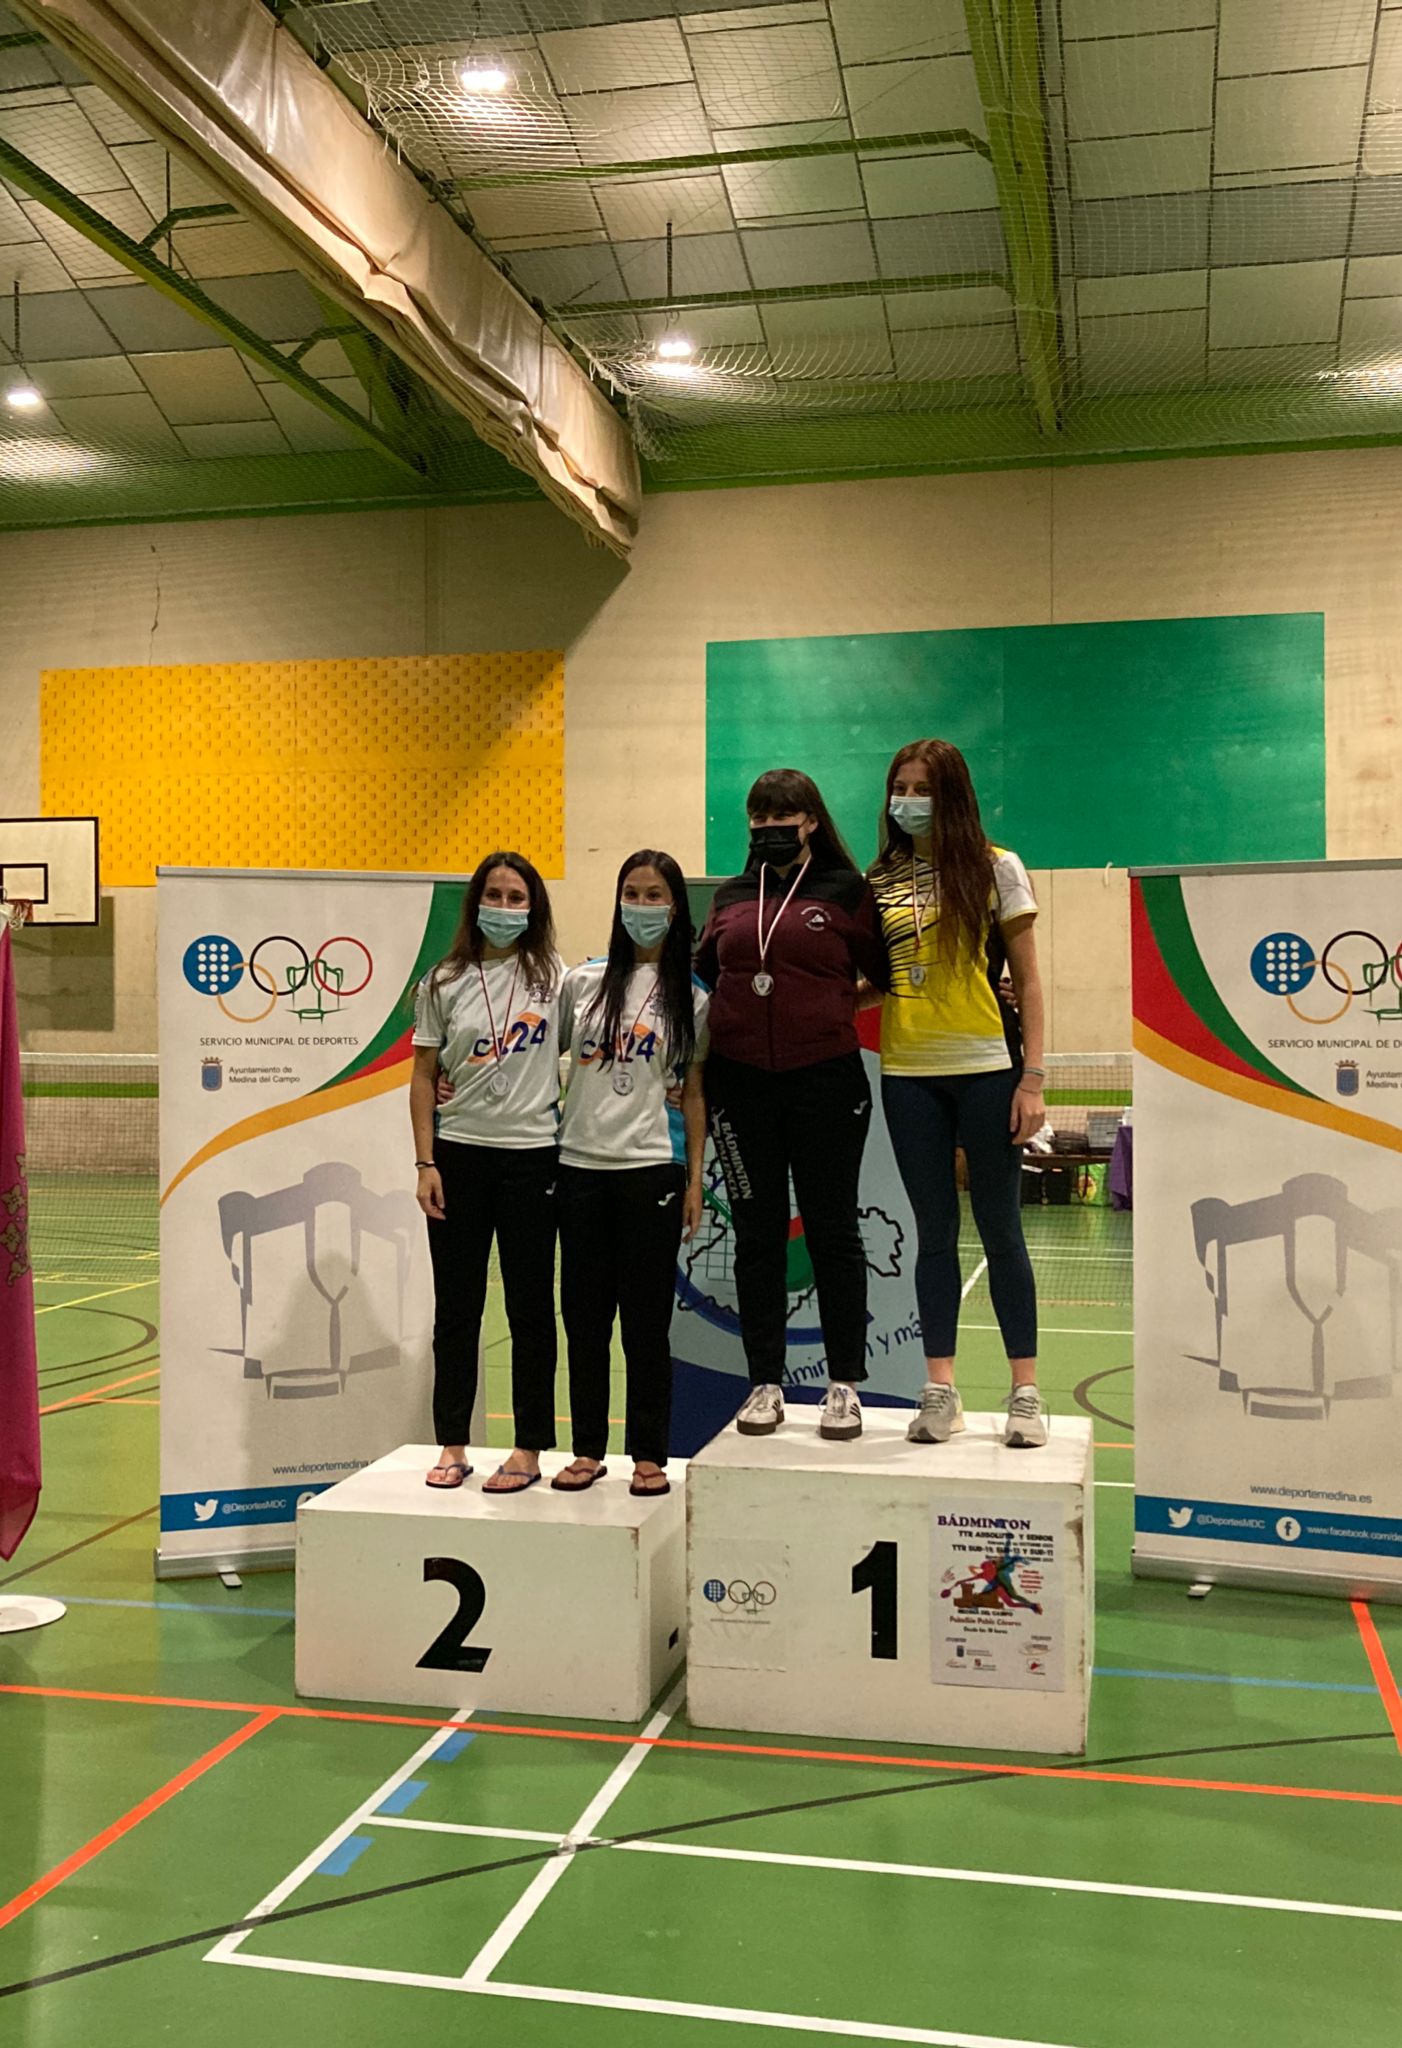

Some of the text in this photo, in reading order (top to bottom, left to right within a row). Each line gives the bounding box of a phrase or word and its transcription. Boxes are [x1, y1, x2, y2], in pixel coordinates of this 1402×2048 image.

[200, 1037, 358, 1046] SERVICIO MUNICIPAL DE DEPORTES
[1268, 1039, 1314, 1048] SERVICIO
[1317, 1039, 1373, 1048] MUNICIPAL
[1376, 1039, 1389, 1048] DE
[229, 1066, 280, 1076] Ayuntamiento
[229, 1075, 257, 1083] Medina
[272, 1075, 300, 1085] Campo
[1366, 1080, 1398, 1088] Medina
[876, 1333, 889, 1355] y
[894, 1311, 923, 1345] má
[1250, 1484, 1373, 1504] www.deportemedina.es
[221, 1498, 287, 1515] @DeportesMDC
[937, 1513, 1031, 1531] BÁDMINTON
[1196, 1513, 1266, 1529] @DeportesMDC
[852, 1541, 898, 1660] 1
[415, 1557, 492, 1673] 2
